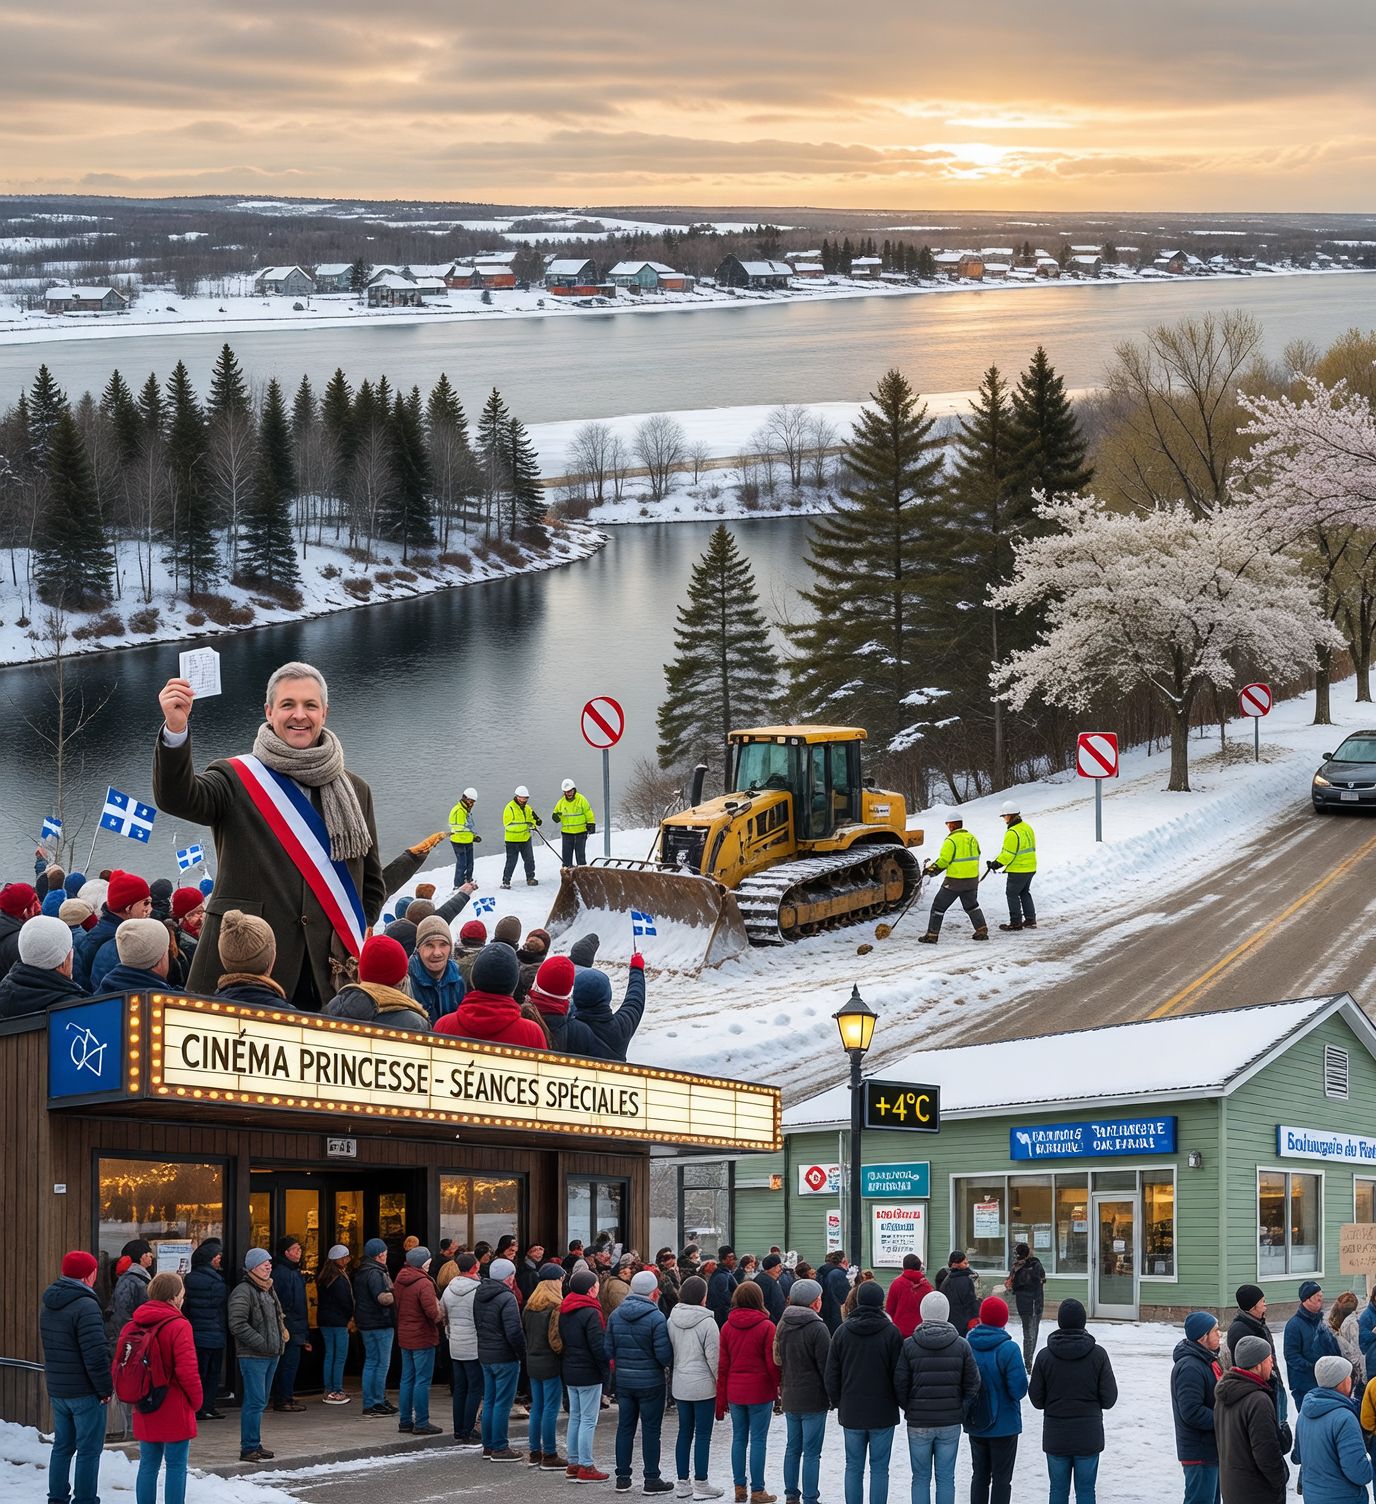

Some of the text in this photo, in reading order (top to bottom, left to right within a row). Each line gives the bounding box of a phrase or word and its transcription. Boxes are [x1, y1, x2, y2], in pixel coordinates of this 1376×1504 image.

[181, 1028, 290, 1078] CINÉMA
[300, 1048, 429, 1094] PRINCESSE
[449, 1060, 539, 1106] SÉANCES
[545, 1076, 639, 1117] SPÉCIALES
[875, 1092, 930, 1123] +4°C
